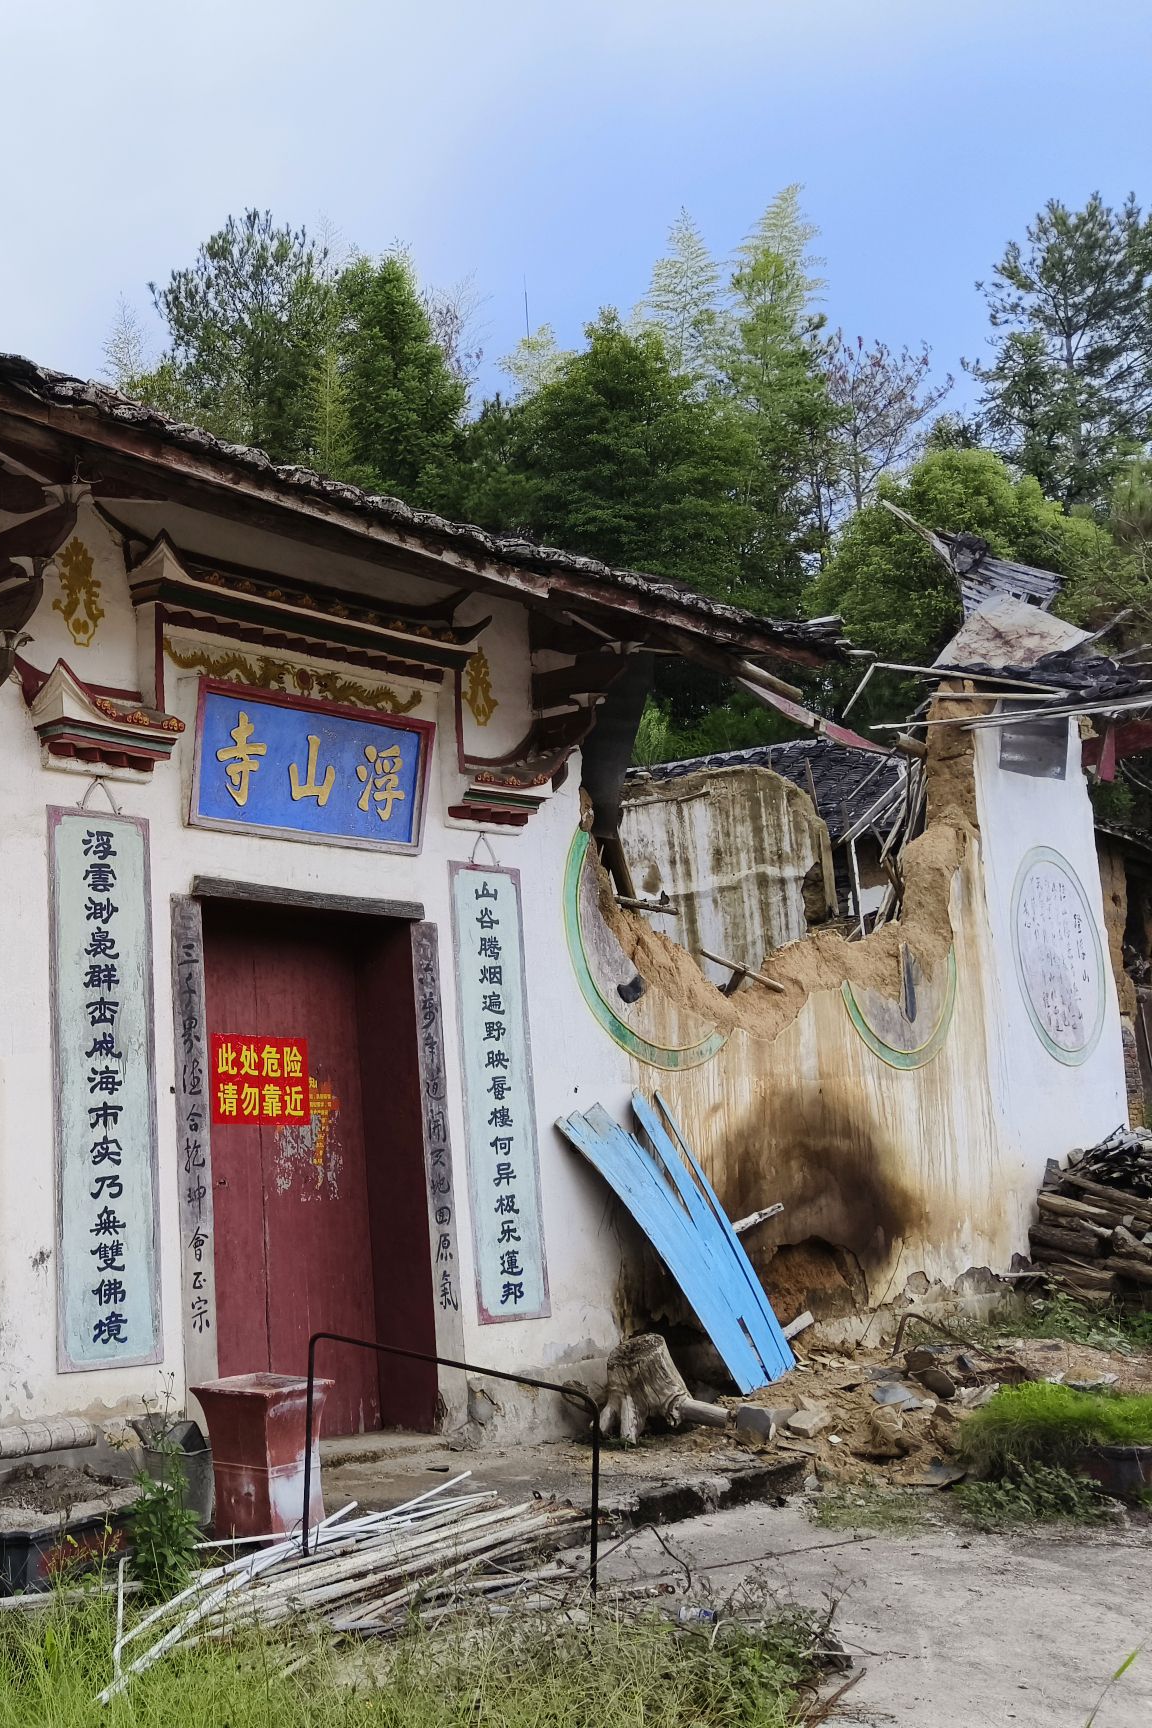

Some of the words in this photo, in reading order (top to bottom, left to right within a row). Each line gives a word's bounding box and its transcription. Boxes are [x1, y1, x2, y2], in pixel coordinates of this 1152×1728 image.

[216, 711, 405, 821] 浮山寺
[217, 1043, 303, 1078] 此处危险
[218, 1083, 305, 1117] 请勿靠近
